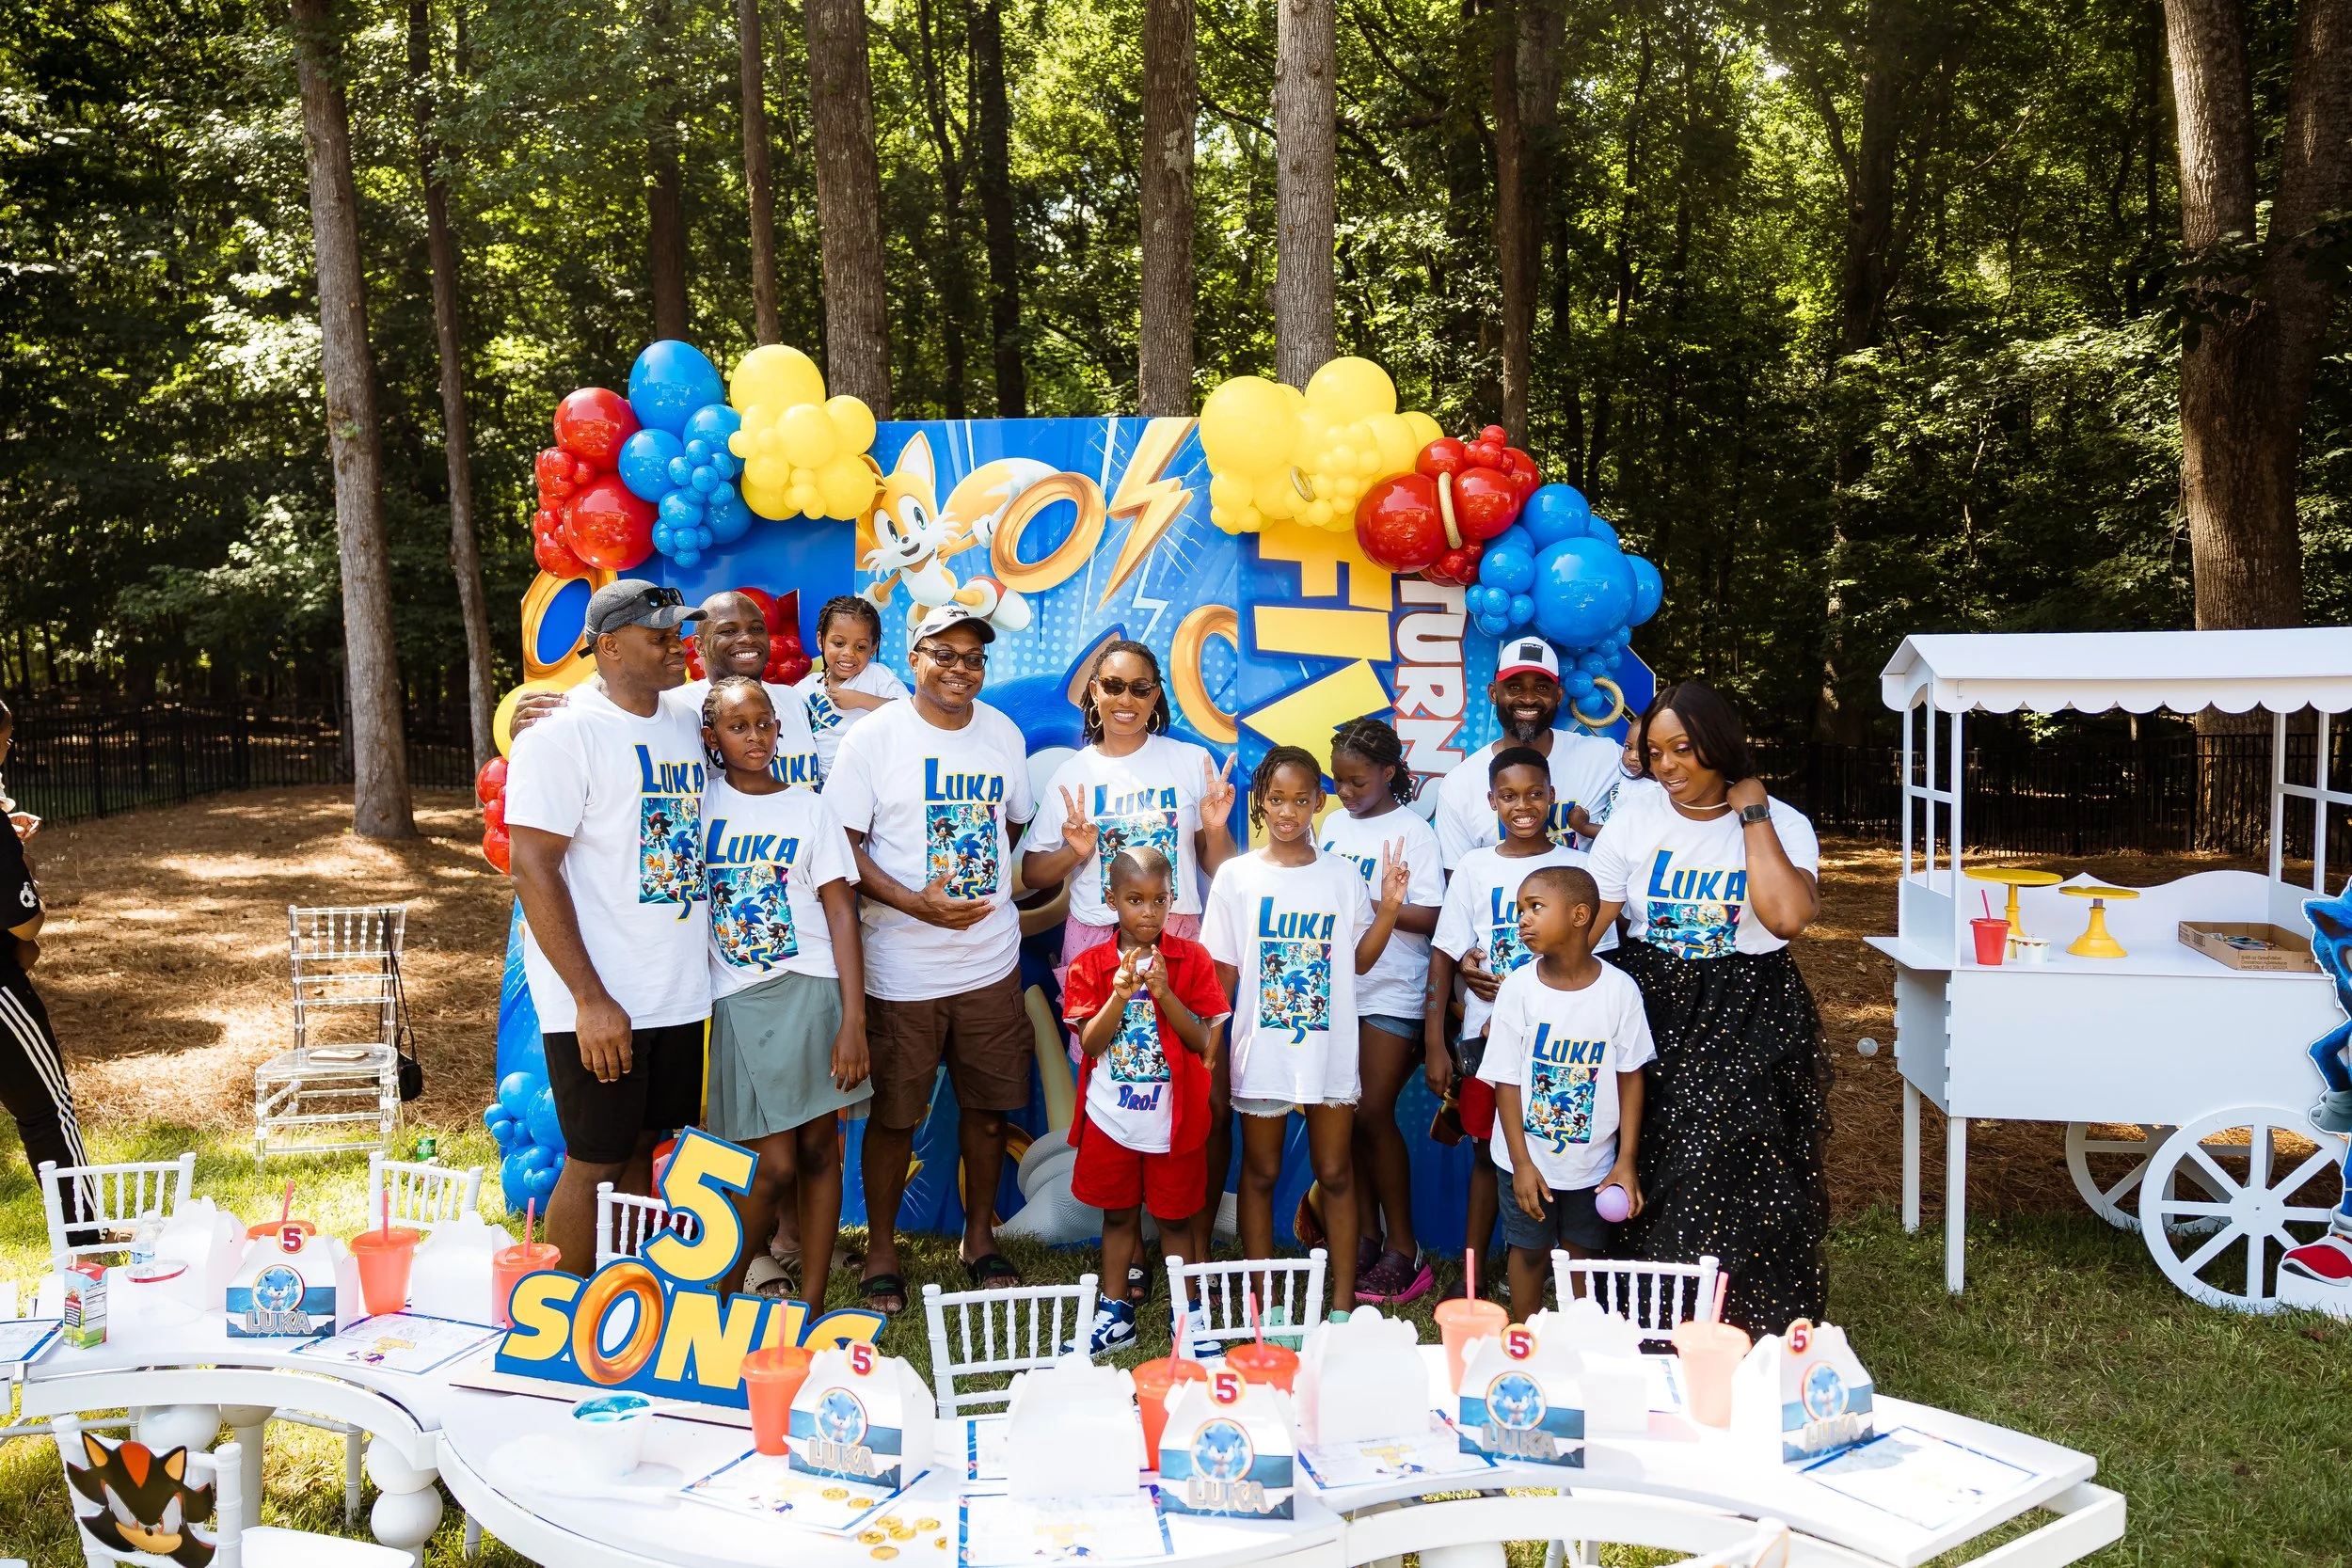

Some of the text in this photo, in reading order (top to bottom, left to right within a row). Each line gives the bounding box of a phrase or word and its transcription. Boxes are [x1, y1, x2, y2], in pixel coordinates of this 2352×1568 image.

[633, 743, 704, 795] LUKA
[771, 752, 819, 784] UKA
[924, 756, 1004, 803] LUKA
[1093, 784, 1178, 819] LUKA
[706, 816, 802, 866] LUKA
[1646, 848, 1747, 903] LUKA
[676, 880, 696, 923] 5
[1257, 895, 1338, 941] LUKA
[1288, 1012, 1311, 1046] 5
[1532, 1022, 1607, 1065] LUKA
[1117, 1084, 1163, 1111] BRO!
[1550, 1128, 1572, 1156] 5
[644, 1129, 757, 1283] 5
[283, 1227, 302, 1252] 5
[246, 1310, 312, 1334] LUKA
[1792, 1324, 1808, 1353] 5
[852, 1344, 872, 1375] 5
[1510, 1330, 1530, 1359] 5
[1216, 1373, 1237, 1404] 5
[807, 1436, 878, 1478] LUKA
[1481, 1422, 1559, 1461] LUKA
[1186, 1476, 1271, 1513] LUKA
